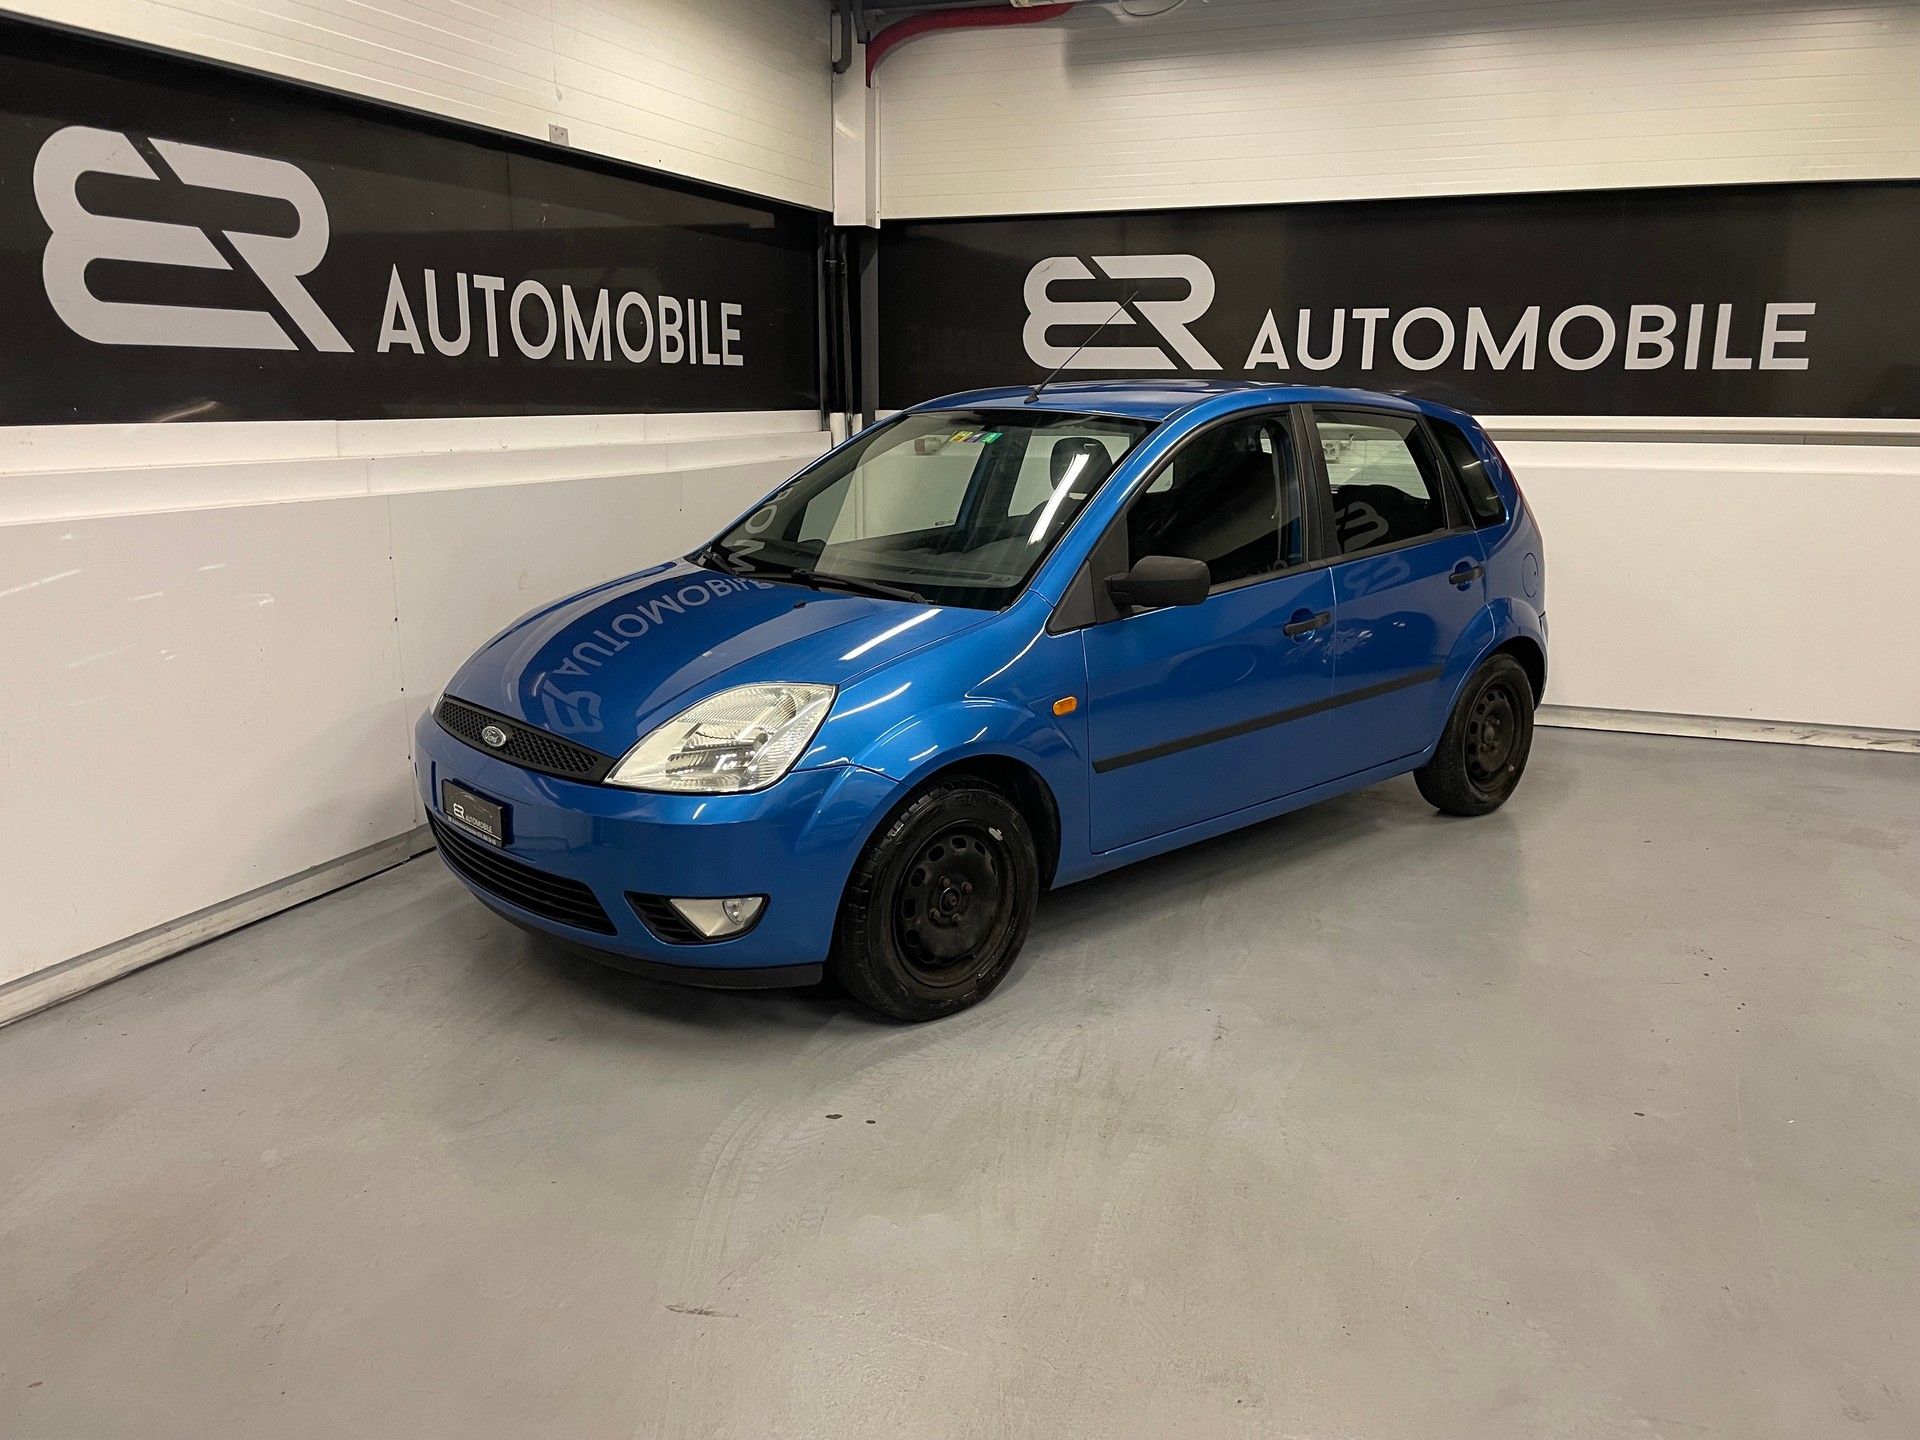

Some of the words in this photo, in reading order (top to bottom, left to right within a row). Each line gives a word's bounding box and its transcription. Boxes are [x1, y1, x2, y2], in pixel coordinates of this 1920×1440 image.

[377, 264, 744, 366] AUTOMOBILE
[1244, 303, 1817, 371] AUTOMOBILE
[465, 815, 493, 834] AUTOMOBILE
